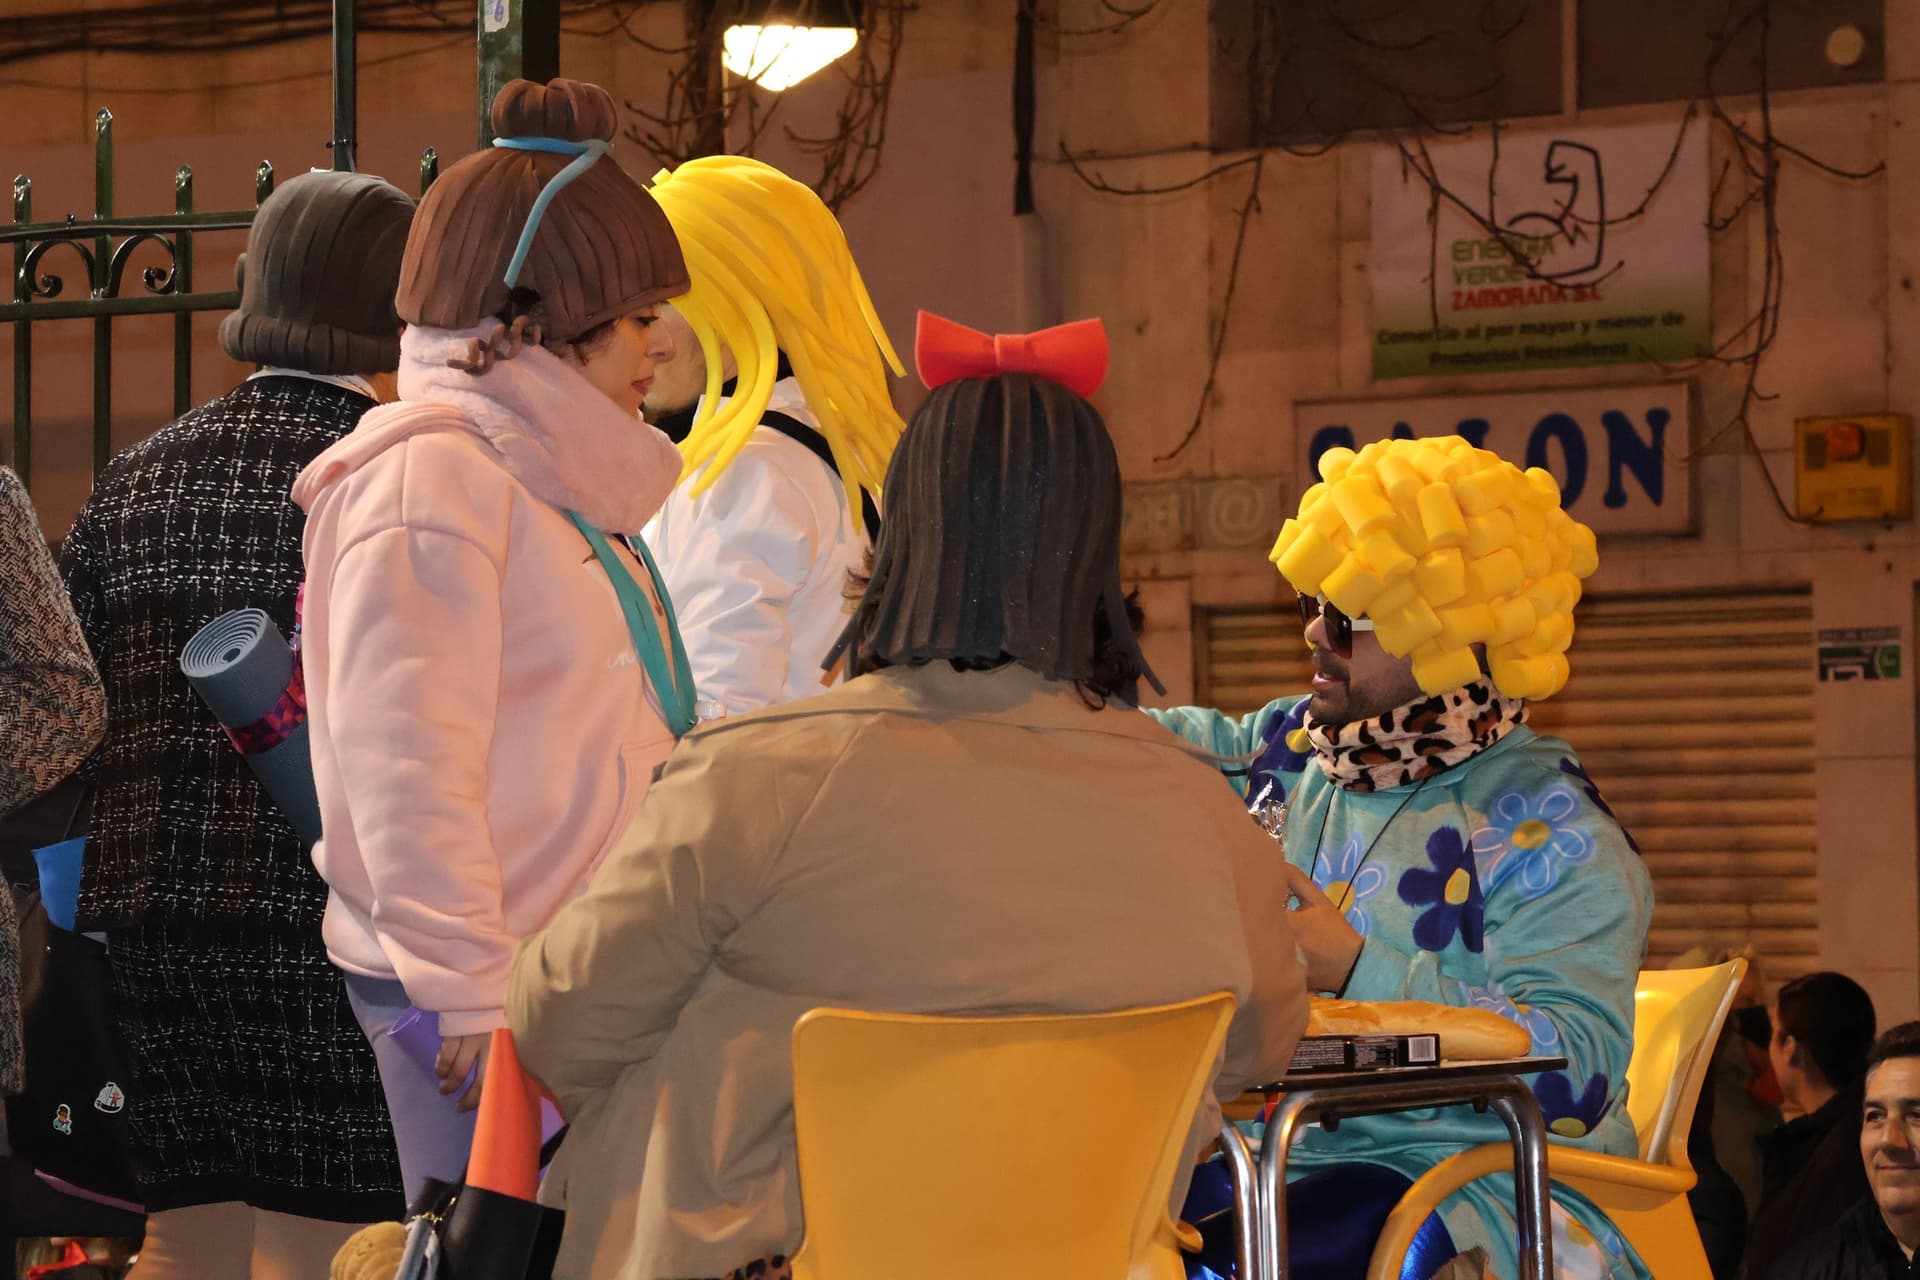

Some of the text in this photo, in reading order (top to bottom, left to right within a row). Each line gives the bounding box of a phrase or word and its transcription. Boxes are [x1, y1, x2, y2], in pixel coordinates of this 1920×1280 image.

[1452, 285, 1567, 312] ZAMORANA
[1465, 323, 1480, 339] al
[1486, 325, 1514, 343] por
[1519, 320, 1576, 336] mayor
[1581, 320, 1591, 337] y
[1661, 311, 1686, 326] de
